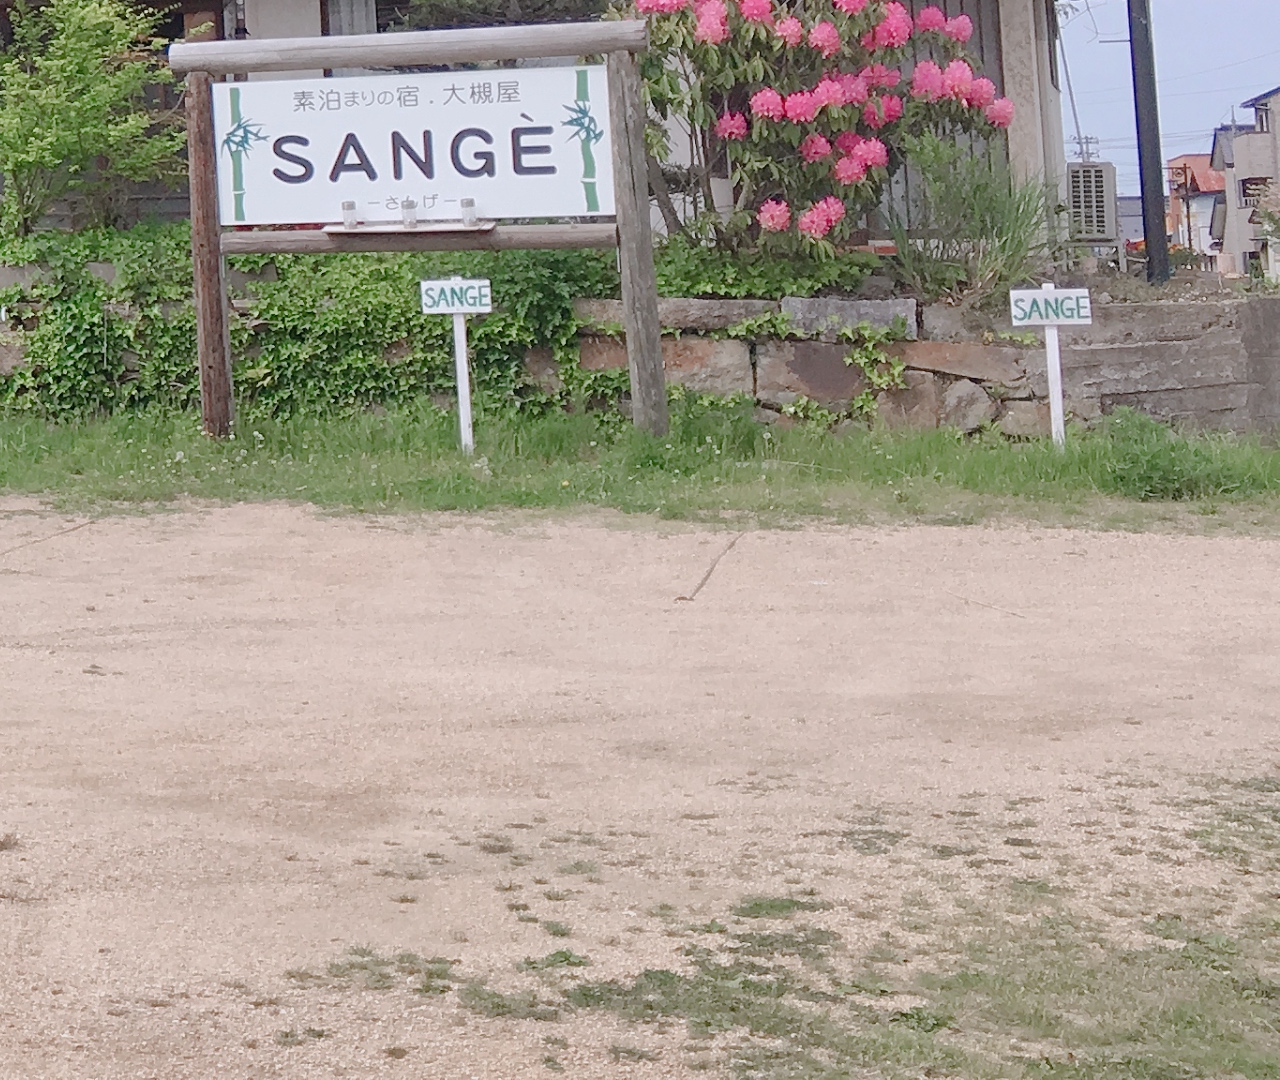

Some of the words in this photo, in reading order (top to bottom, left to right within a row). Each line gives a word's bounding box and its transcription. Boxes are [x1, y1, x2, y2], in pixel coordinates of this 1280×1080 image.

[271, 111, 558, 185] SANGÈ
[424, 284, 491, 309] SANGE
[1012, 295, 1091, 321] SANGE
